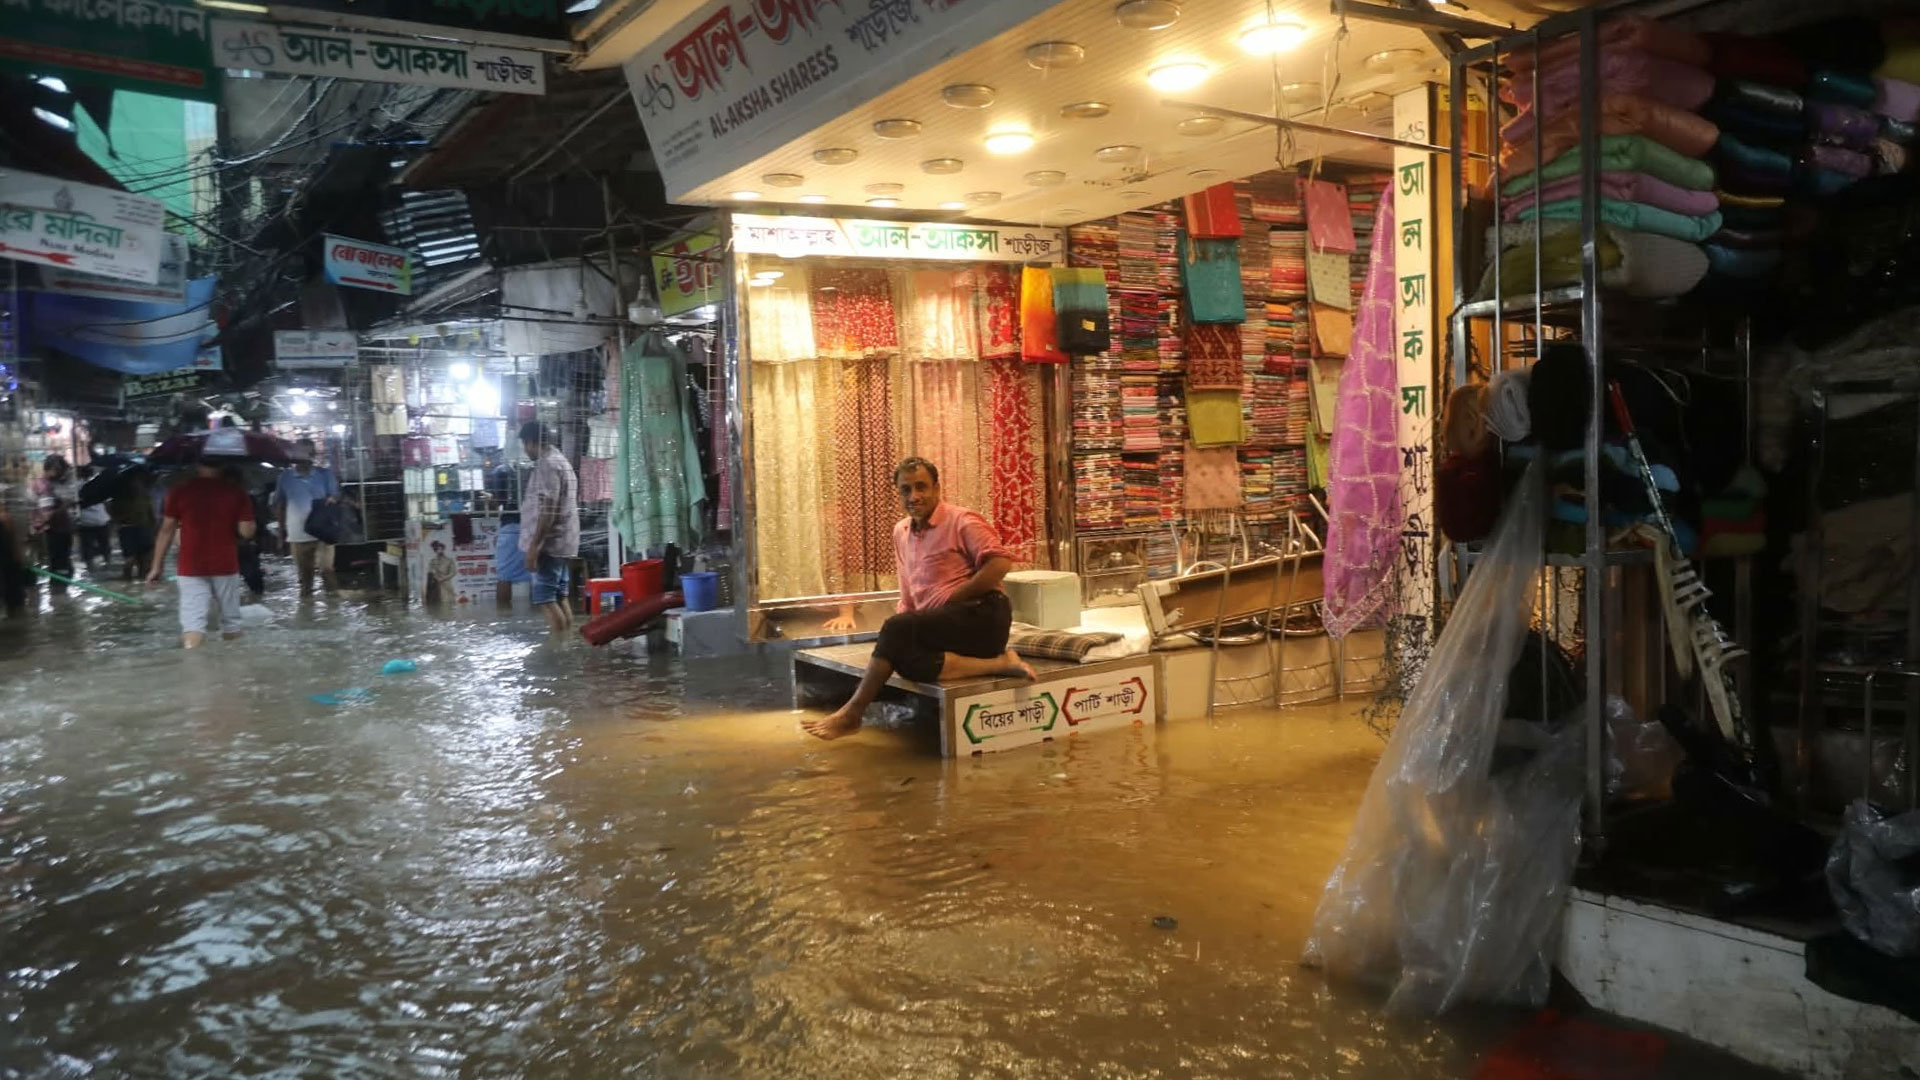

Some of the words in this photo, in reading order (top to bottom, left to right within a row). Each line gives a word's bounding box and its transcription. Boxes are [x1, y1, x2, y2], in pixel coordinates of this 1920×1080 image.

[278, 31, 470, 79] আল-আকসা
[709, 86, 773, 139] AL-AKSHA
[769, 43, 840, 104] SHARESS
[854, 225, 999, 253] আল-আকসা
[979, 710, 1015, 731] বিয়ের
[1018, 700, 1046, 724] শাড়ী
[1074, 692, 1101, 714] পার্টি
[1105, 687, 1136, 707] শাড়ী
